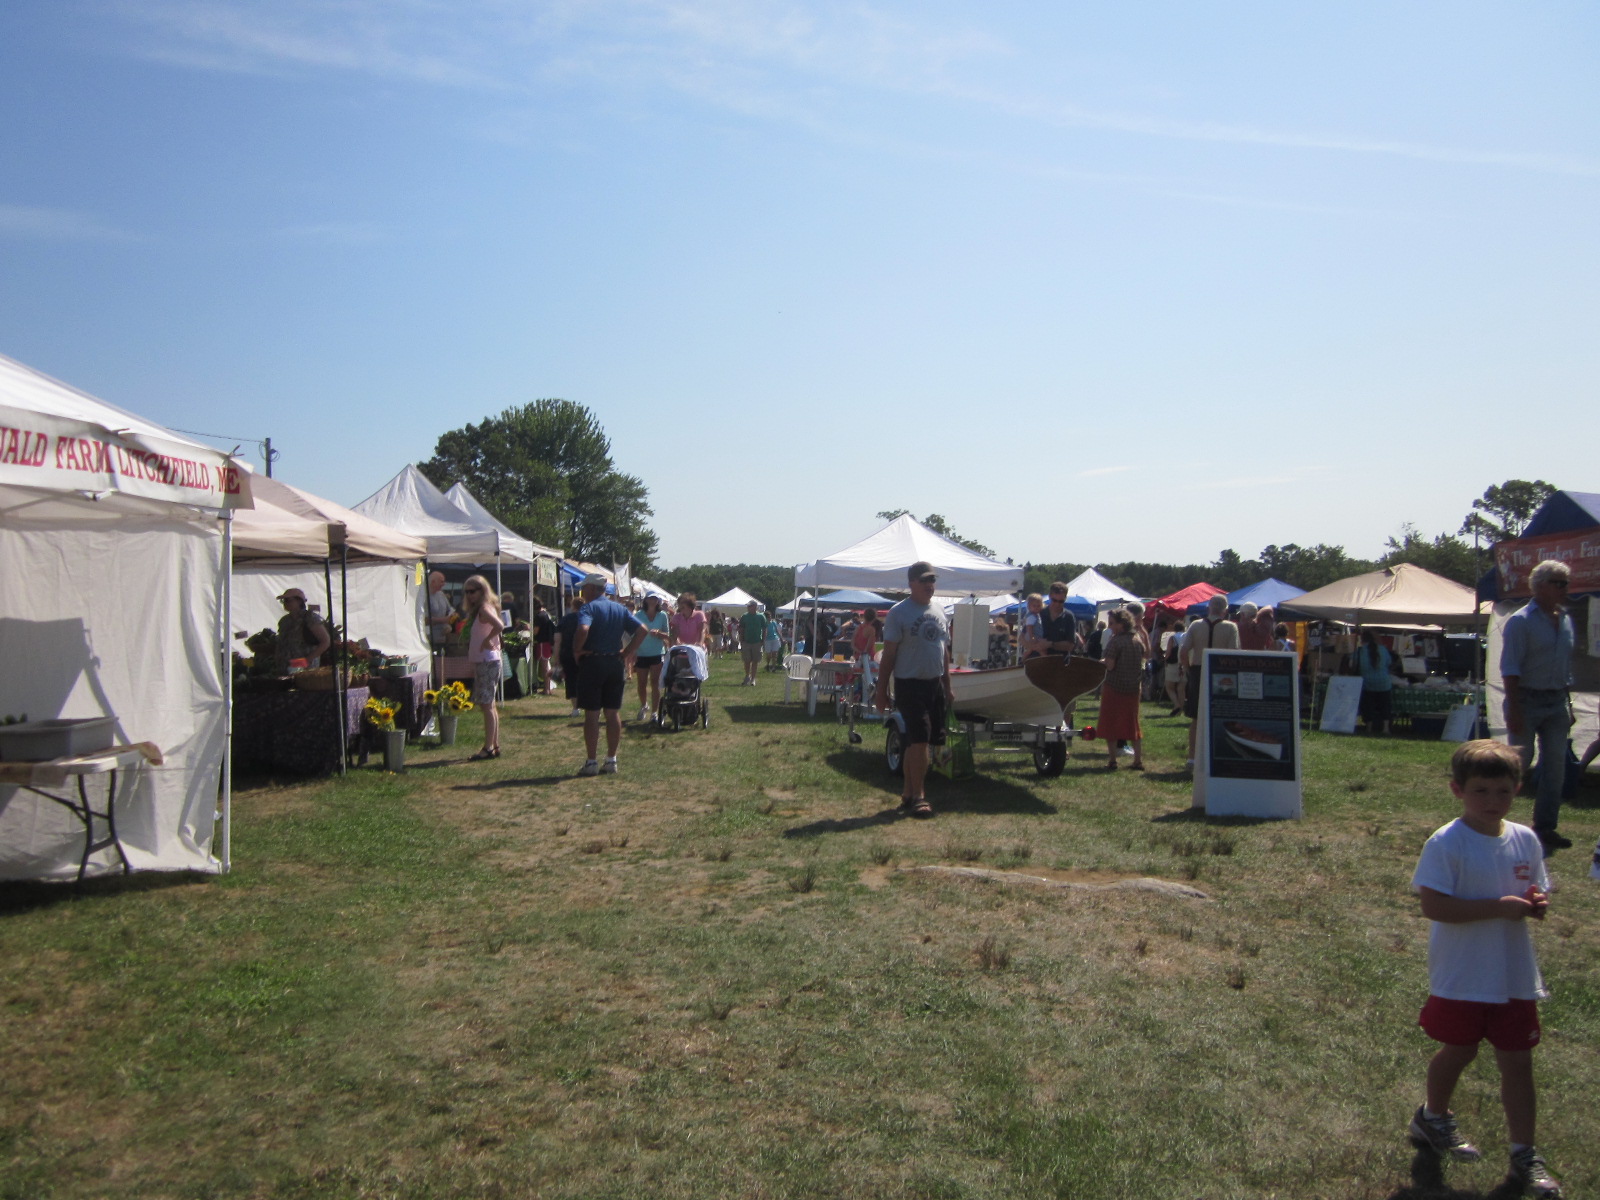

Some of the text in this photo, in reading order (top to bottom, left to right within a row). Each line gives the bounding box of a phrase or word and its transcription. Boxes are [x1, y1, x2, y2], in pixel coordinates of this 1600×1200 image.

[55, 436, 115, 474] FARM
[115, 445, 214, 496] LITCHFIELD,
[215, 466, 241, 495] ME
[1511, 549, 1532, 567] The
